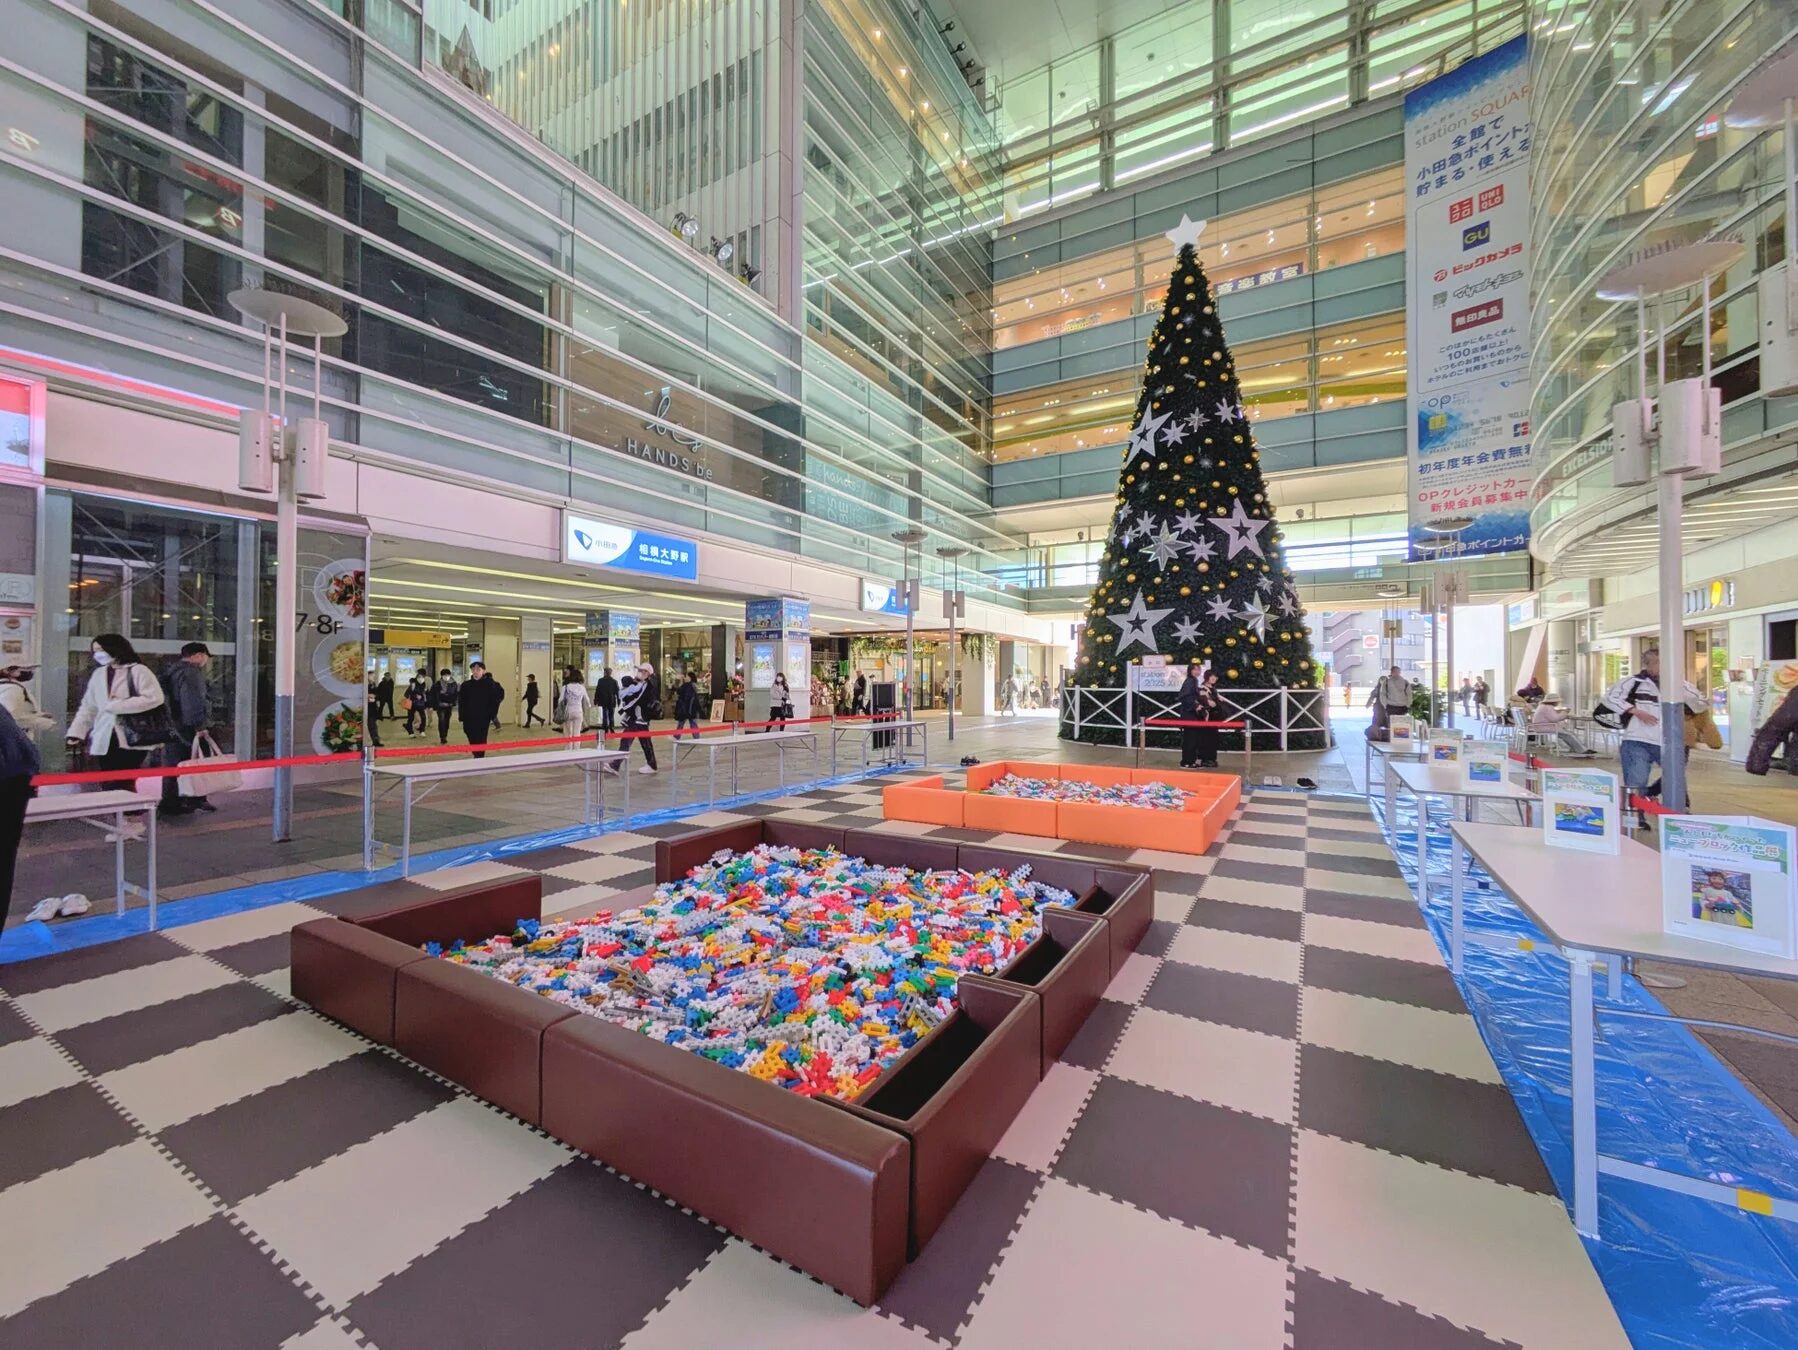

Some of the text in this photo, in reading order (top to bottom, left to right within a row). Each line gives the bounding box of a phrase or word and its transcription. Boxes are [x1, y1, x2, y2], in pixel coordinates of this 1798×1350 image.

[1415, 118, 1468, 149] station
[1451, 115, 1504, 150] 全館で
[1464, 227, 1489, 244] GU
[1452, 242, 1523, 275] ビックカメラ
[1455, 305, 1500, 327] 無印良品
[1439, 326, 1517, 354] このほかにもたくさん
[1434, 344, 1522, 373] いつものお買いものから
[626, 437, 713, 480] HANDS be
[1430, 489, 1528, 513] 新規会員募集中
